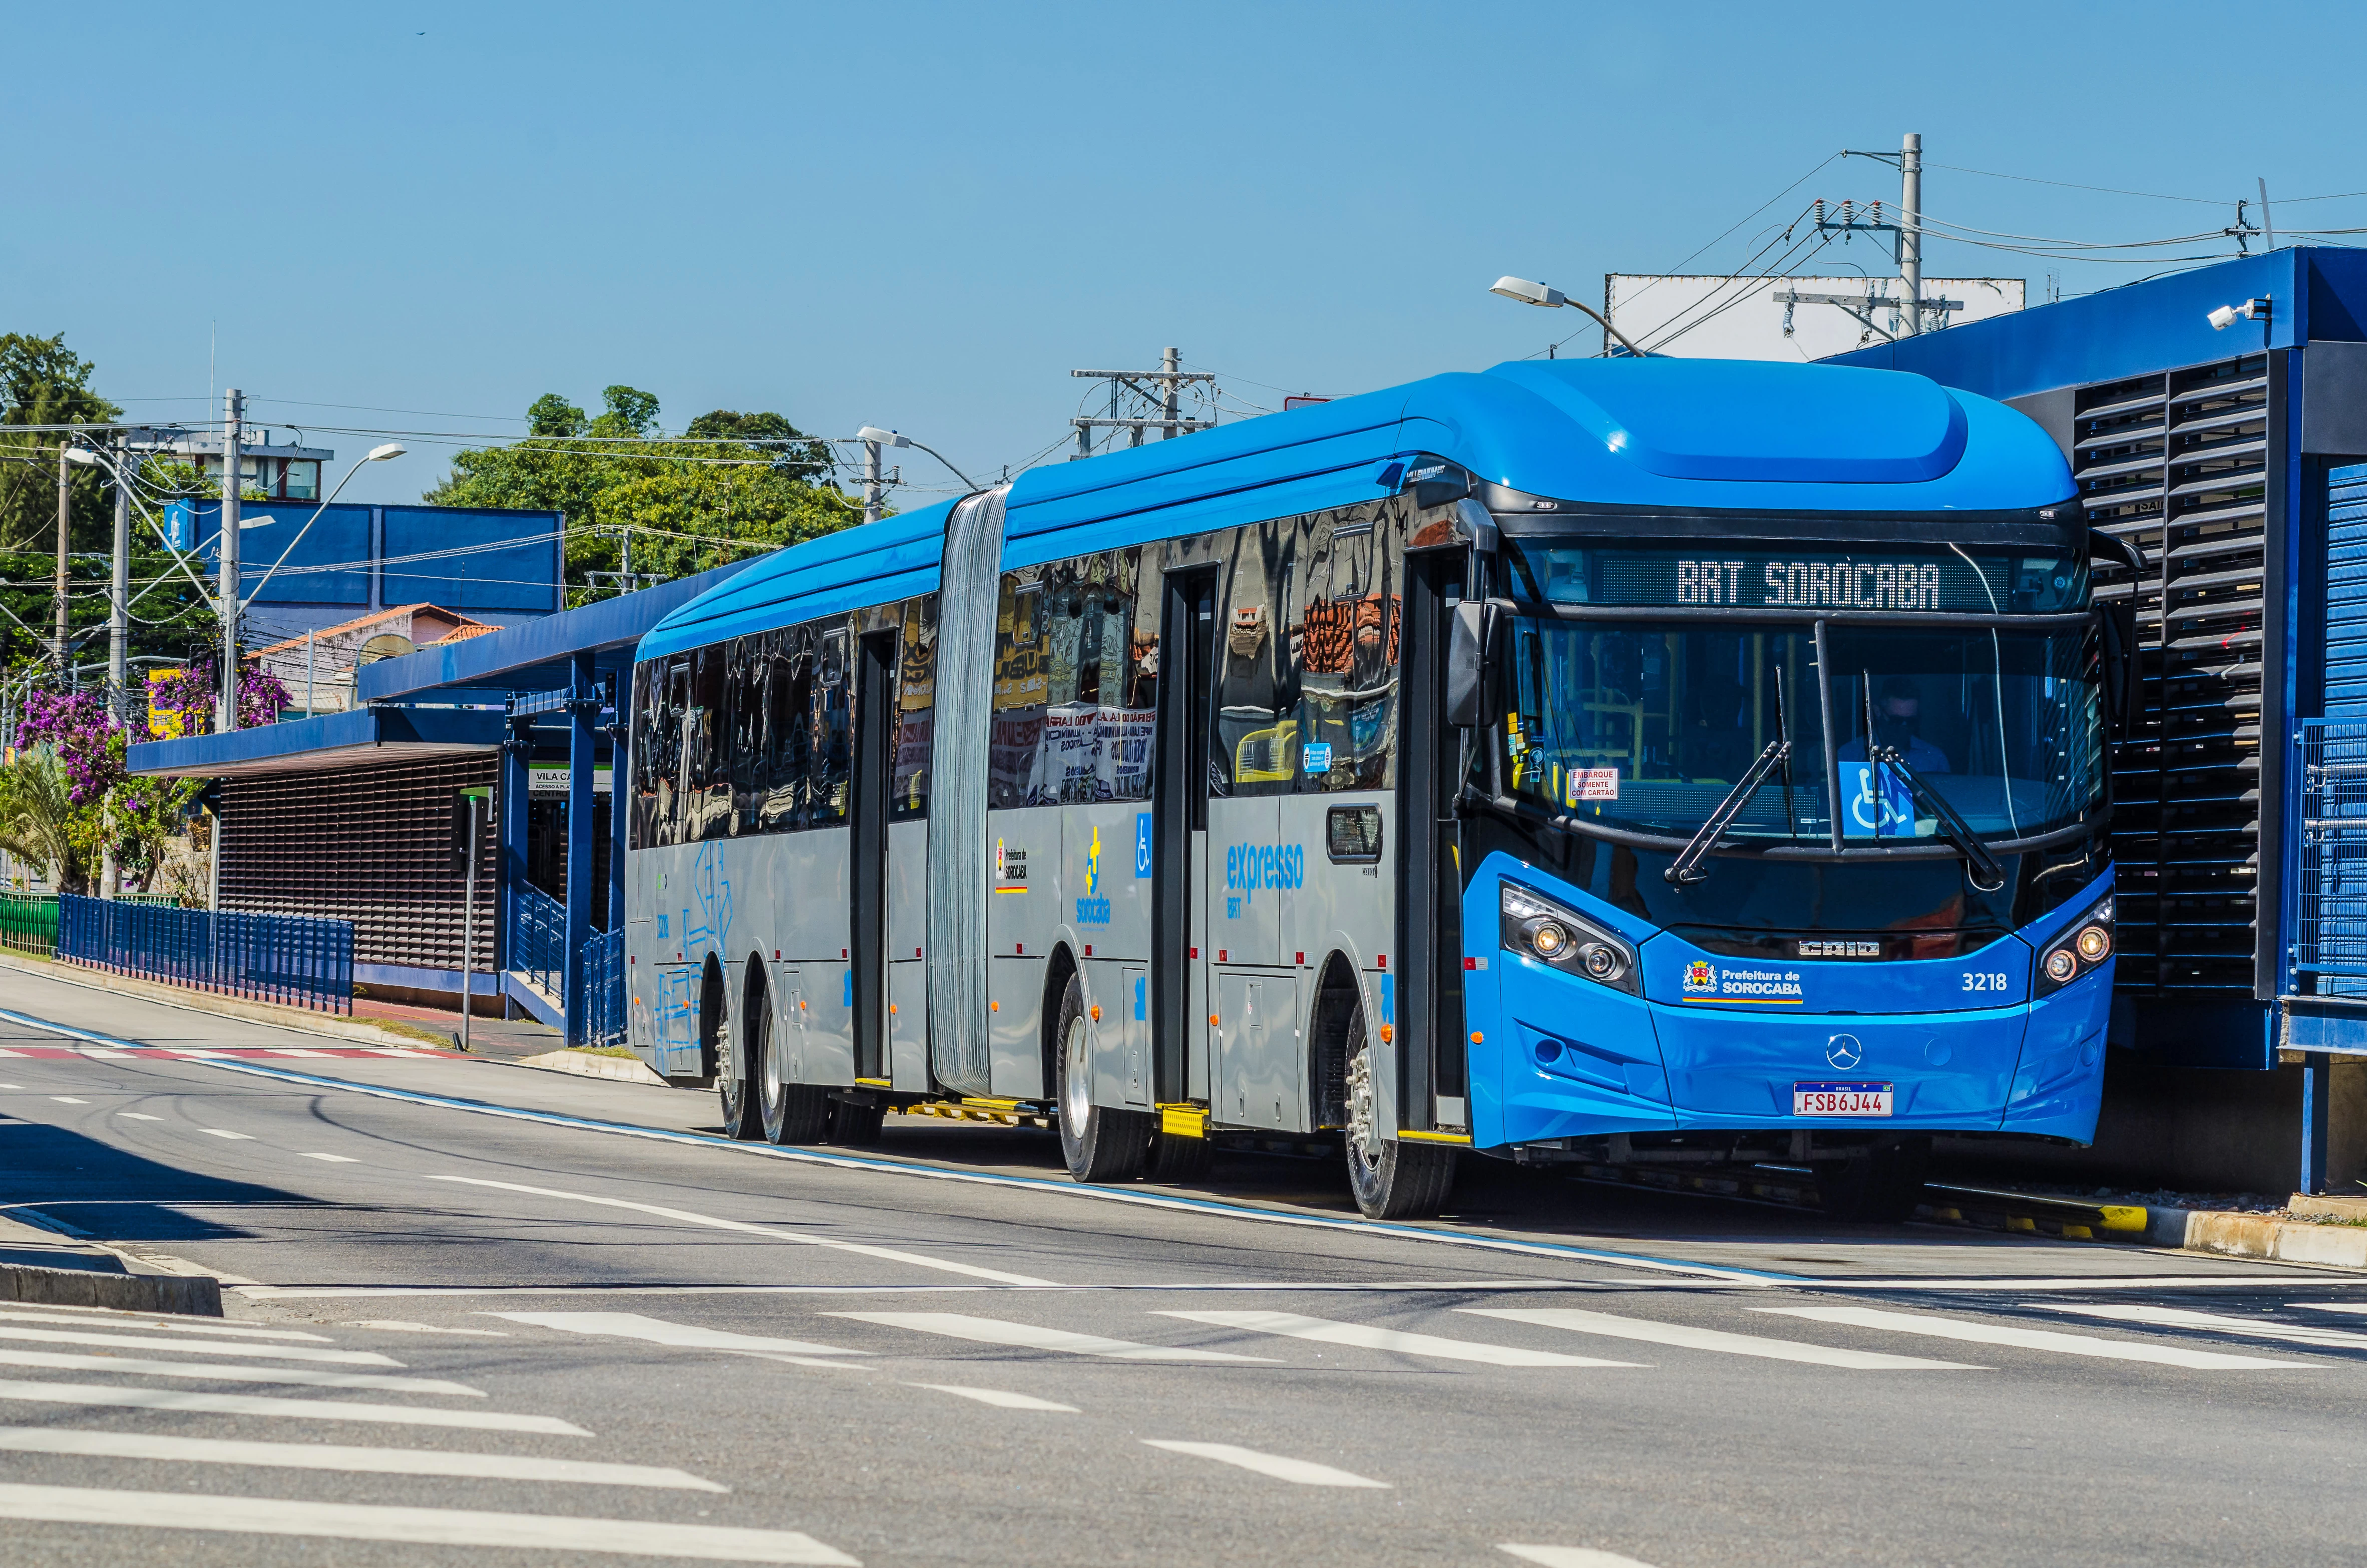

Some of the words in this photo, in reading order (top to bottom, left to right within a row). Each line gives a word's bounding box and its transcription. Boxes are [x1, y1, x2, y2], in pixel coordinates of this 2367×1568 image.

[1678, 560, 1744, 603] BRT
[1765, 561, 1939, 609] SOROCABA
[1005, 849, 1021, 861] Prefeitura
[1022, 848, 1026, 860] de
[1005, 865, 1027, 880] SOROCABA
[1227, 842, 1304, 904] expresso
[1076, 892, 1110, 924] sorocaba
[1799, 941, 1879, 956] CAIO
[1722, 970, 1782, 981] Prefeitura
[1785, 970, 1800, 981] de
[1962, 973, 2007, 991] 3218
[1722, 982, 1803, 995] SOROCABA
[1804, 1093, 1882, 1112] FSB6J44
